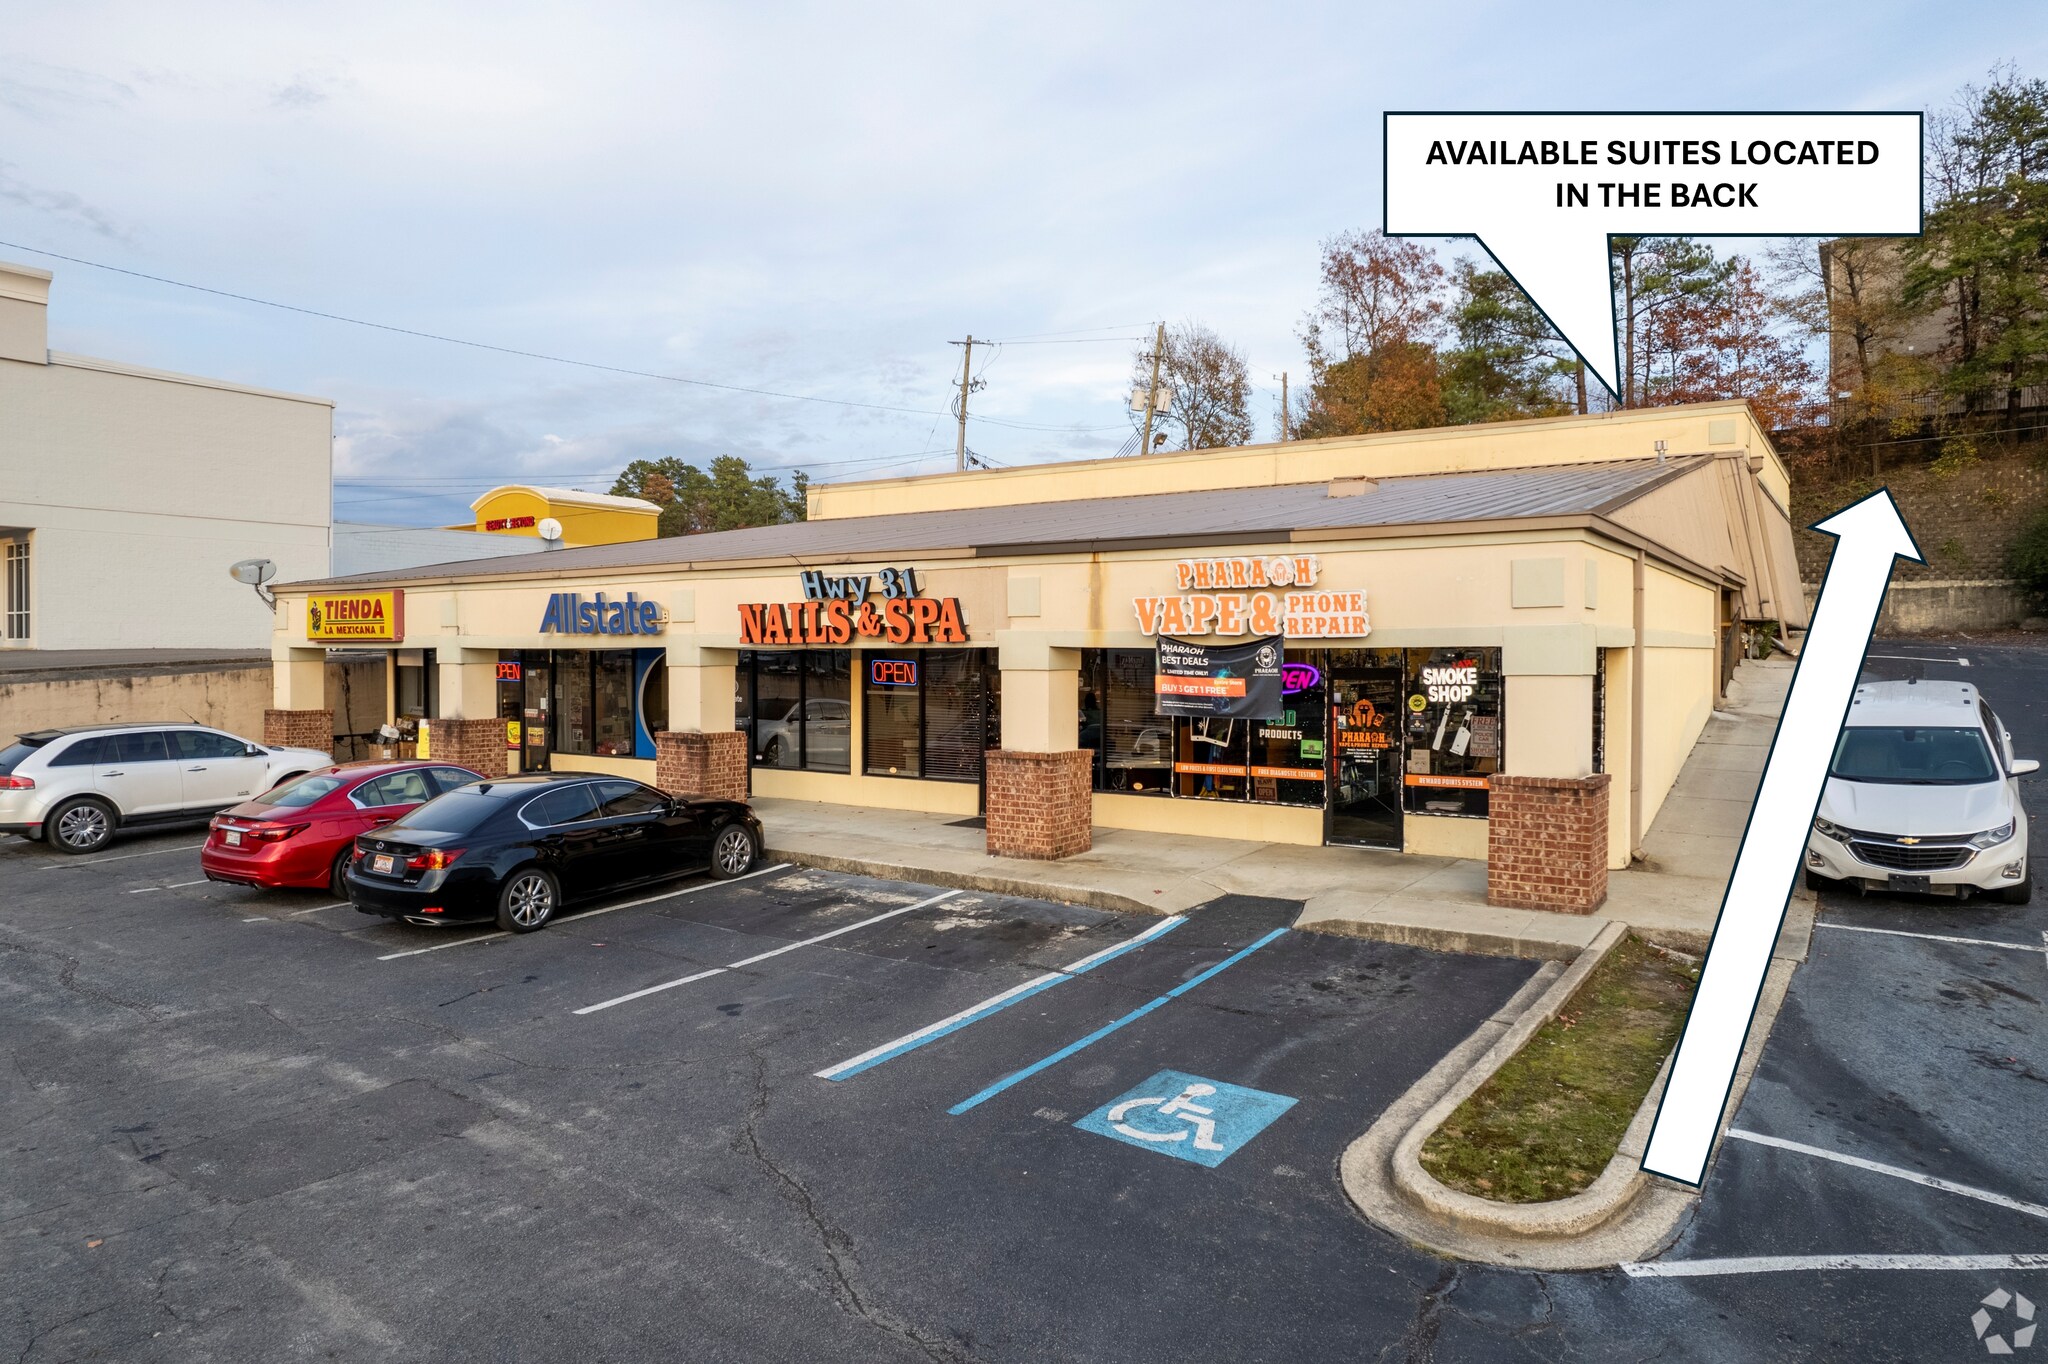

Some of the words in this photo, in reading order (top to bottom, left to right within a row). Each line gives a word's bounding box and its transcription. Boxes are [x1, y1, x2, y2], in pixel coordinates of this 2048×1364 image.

[800, 570, 869, 605] Hwy
[879, 567, 918, 599] 31
[325, 598, 384, 619] TIENDA
[1289, 593, 1362, 614] PHONE
[539, 592, 660, 635] Allstate
[737, 599, 852, 644] NAILS
[885, 597, 968, 644] SPA
[1133, 595, 1243, 635] VAPE
[1251, 594, 1279, 634] &
[324, 626, 334, 635] LA
[336, 625, 376, 635] MEXICANA
[379, 625, 385, 634] II
[1287, 615, 1366, 635] REPAIR
[1161, 644, 1204, 656] PHARAOH
[1161, 656, 1182, 666] BEST
[1182, 656, 1209, 666] DEALS
[496, 663, 520, 680] OPEN
[873, 661, 915, 684] OPEN
[1281, 670, 1313, 689] PEN
[1422, 667, 1478, 685] SMOKE
[1161, 684, 1178, 692] BUY
[1178, 684, 1183, 693] 3
[1184, 685, 1199, 693] GET
[1200, 685, 1205, 693] 1
[1428, 685, 1473, 702] SHOP
[1471, 717, 1495, 725] FREE
[1259, 728, 1303, 740] PRODUCTS
[1270, 769, 1297, 777] DIAGNOSTIC
[1298, 770, 1318, 778] TESTING
[1418, 777, 1441, 785] REWARD
[1441, 778, 1461, 786] POINTS
[1462, 779, 1484, 787] SYSTEM
